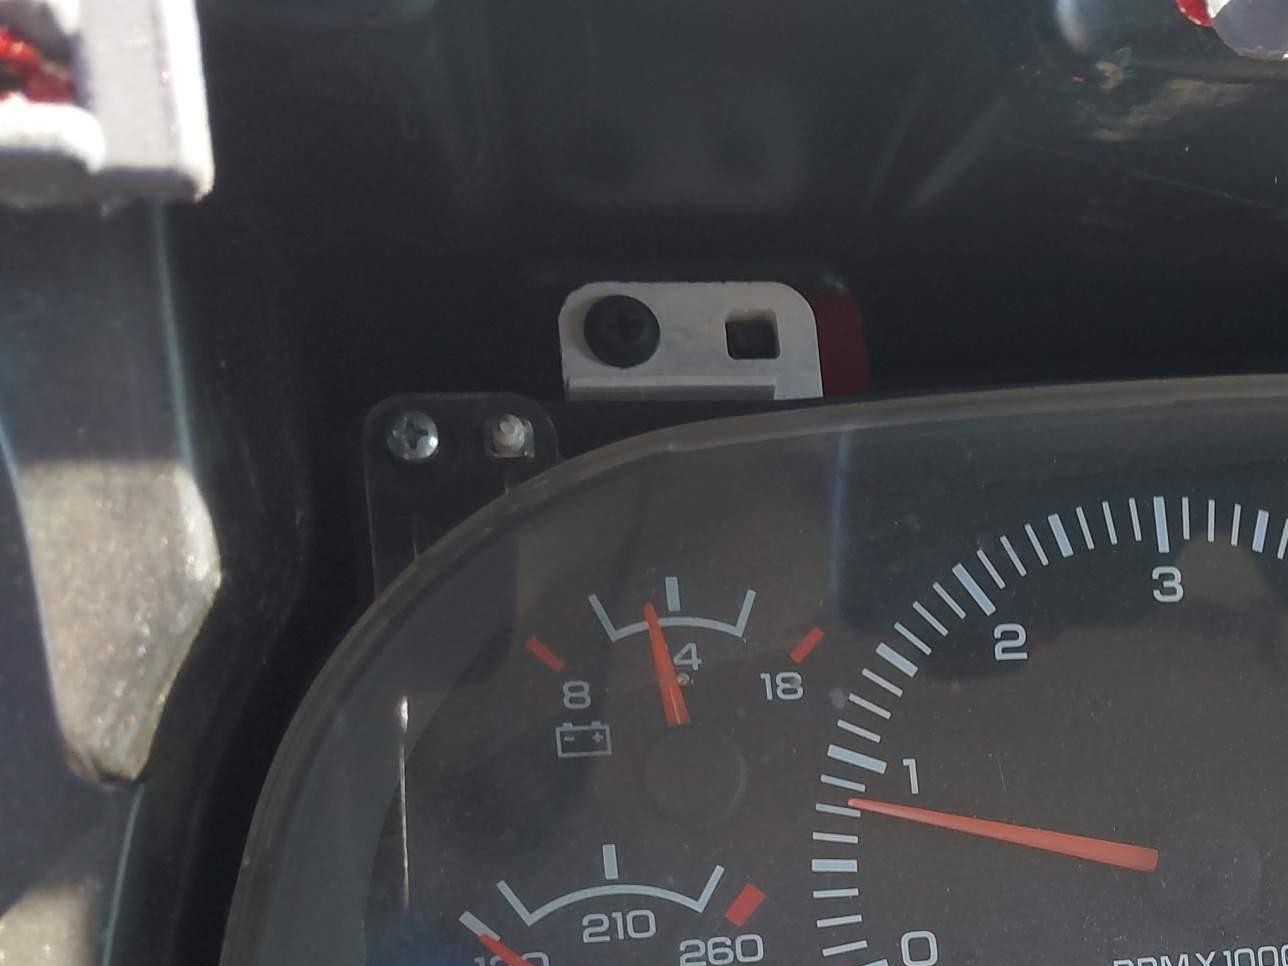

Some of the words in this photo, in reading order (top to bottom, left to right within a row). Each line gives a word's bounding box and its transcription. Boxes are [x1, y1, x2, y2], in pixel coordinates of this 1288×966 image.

[1152, 565, 1185, 602] 3
[994, 622, 1029, 661] 2
[562, 680, 592, 710] 8
[760, 671, 804, 701] 18
[903, 758, 919, 795] 1
[582, 909, 657, 943] 210
